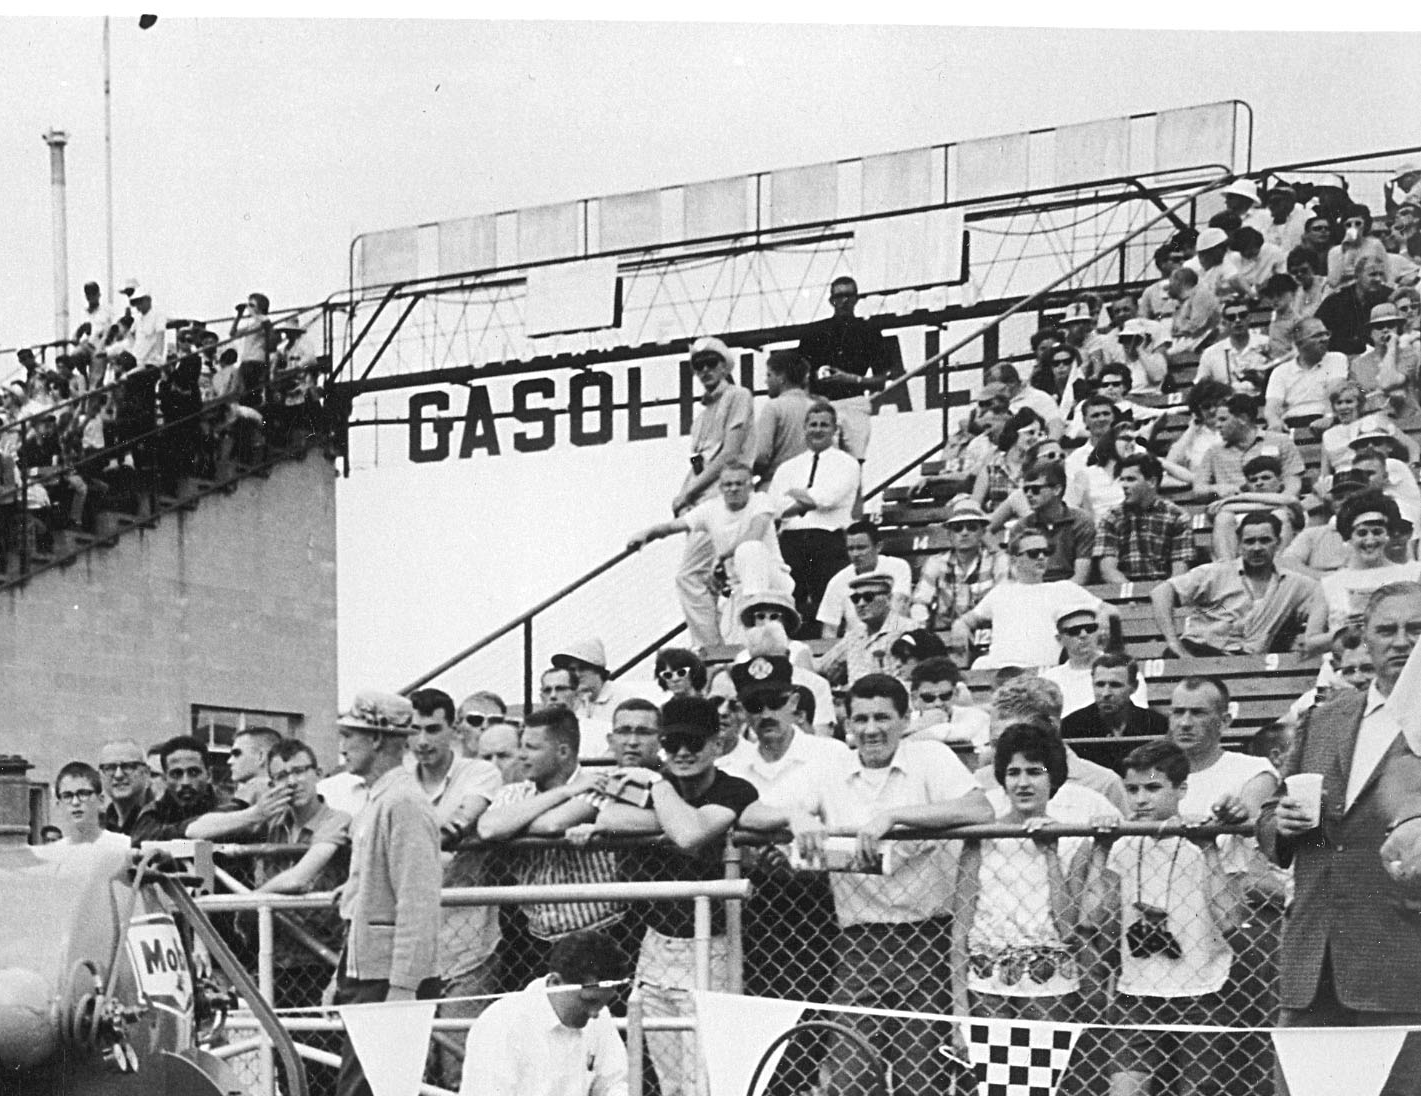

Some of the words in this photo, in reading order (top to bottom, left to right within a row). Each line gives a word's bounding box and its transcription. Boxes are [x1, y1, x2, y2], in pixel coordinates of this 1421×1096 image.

[408, 355, 754, 463] GASOLI
[912, 535, 929, 551] 14
[1144, 658, 1165, 677] 10
[1265, 652, 1279, 671] 9
[140, 937, 187, 974] Mob
